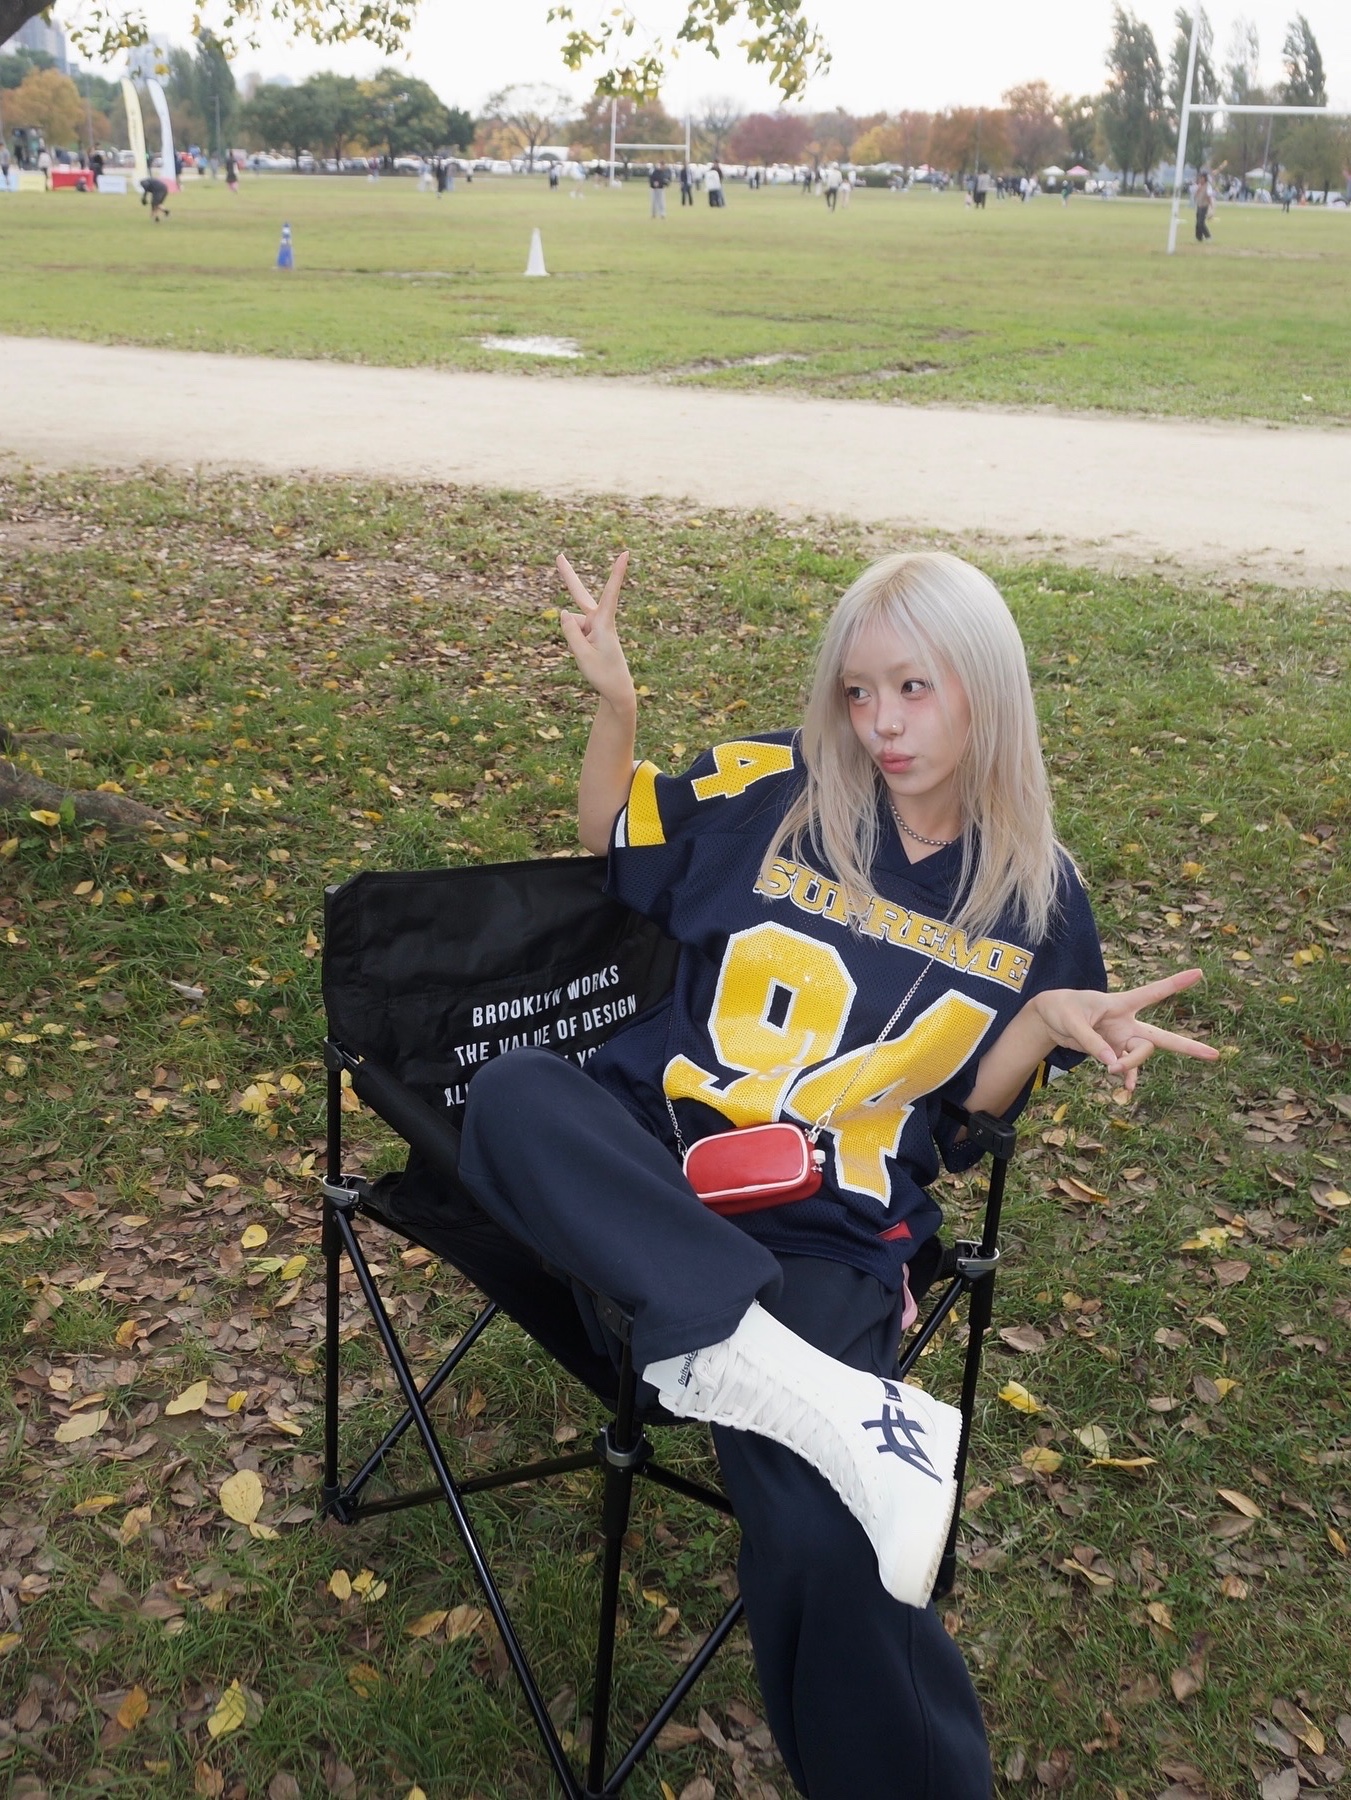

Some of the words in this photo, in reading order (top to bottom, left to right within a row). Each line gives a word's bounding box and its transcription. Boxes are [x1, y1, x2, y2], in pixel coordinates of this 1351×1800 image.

[691, 741, 794, 801] 4
[472, 987, 562, 1027] BROOKLYN
[567, 965, 619, 1000] WORKS
[454, 1042, 489, 1066] THE
[557, 1016, 576, 1040] OF
[582, 994, 636, 1032] DESIGN
[663, 921, 997, 1207] 94
